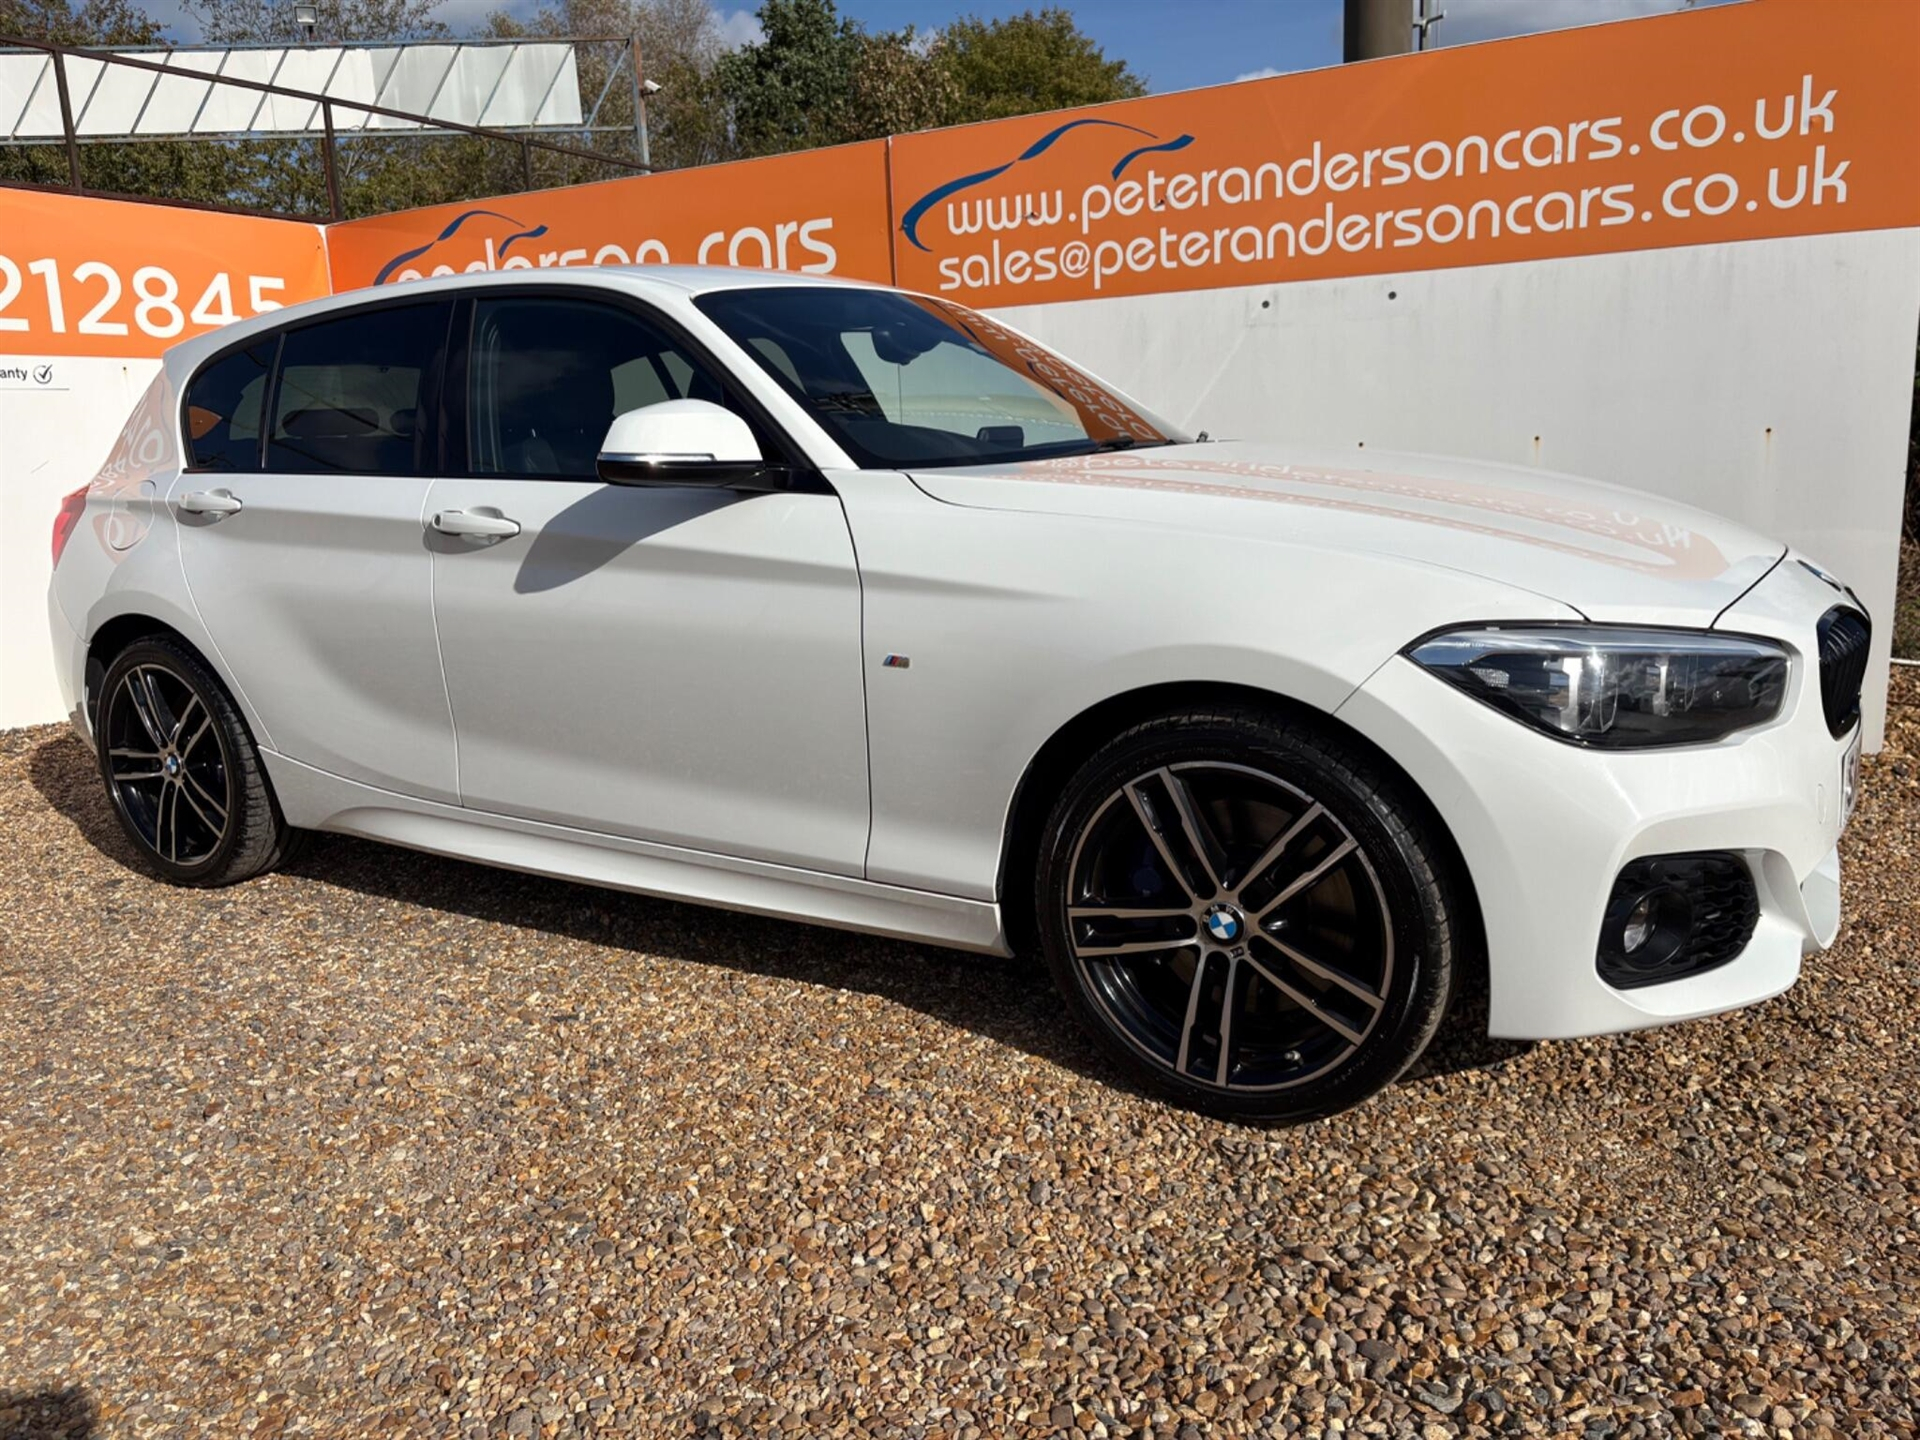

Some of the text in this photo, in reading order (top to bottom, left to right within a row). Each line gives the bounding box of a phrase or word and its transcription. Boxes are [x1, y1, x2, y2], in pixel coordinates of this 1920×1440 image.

[939, 145, 1850, 289] sales@peterandersoncars.co.uk
[947, 74, 1837, 234] www.peterandersoncars.co.uk
[698, 217, 836, 275] cars
